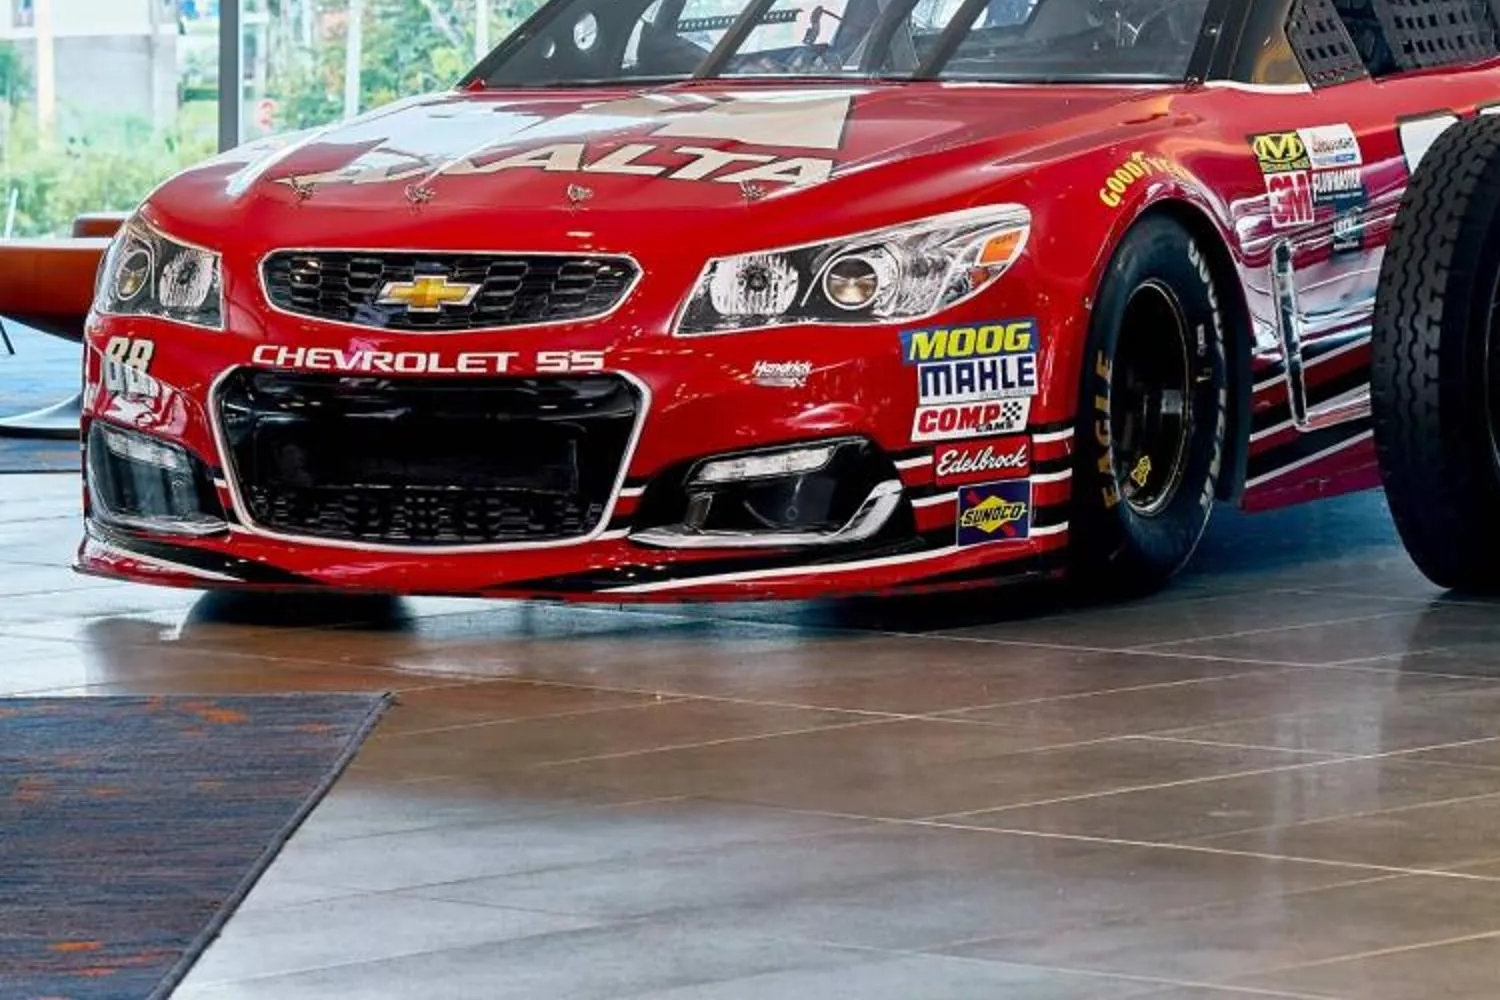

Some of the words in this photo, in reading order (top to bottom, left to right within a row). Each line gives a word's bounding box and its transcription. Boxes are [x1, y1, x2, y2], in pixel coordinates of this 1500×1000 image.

[909, 322, 1033, 360] MOOG
[251, 344, 520, 373] CHEVROLET
[535, 351, 606, 373] SS
[919, 356, 1035, 397] MAHLE
[917, 403, 1001, 434] COMP
[936, 443, 1027, 476] Edelbrock
[962, 504, 1023, 524] SUNOCO
